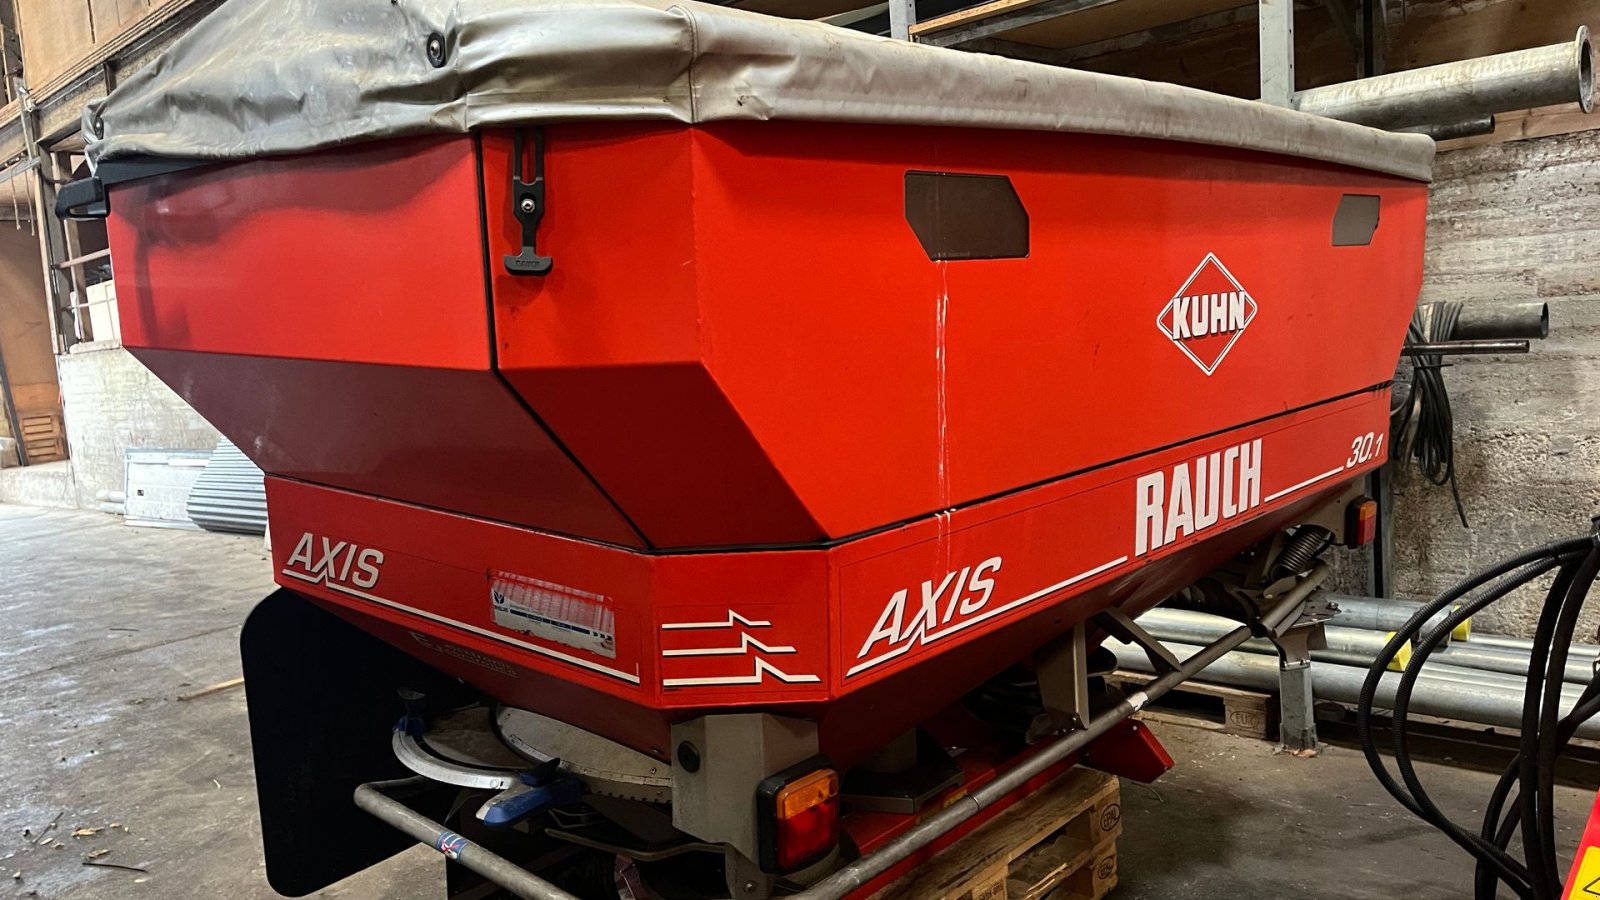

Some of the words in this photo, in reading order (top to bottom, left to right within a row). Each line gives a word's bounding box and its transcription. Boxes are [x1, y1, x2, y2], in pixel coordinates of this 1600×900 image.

[1172, 290, 1245, 341] KUHN
[1346, 431, 1384, 469] 30.1
[1135, 438, 1262, 557] RAUCH
[286, 531, 385, 589] AXIS
[856, 556, 1003, 660] AXIS
